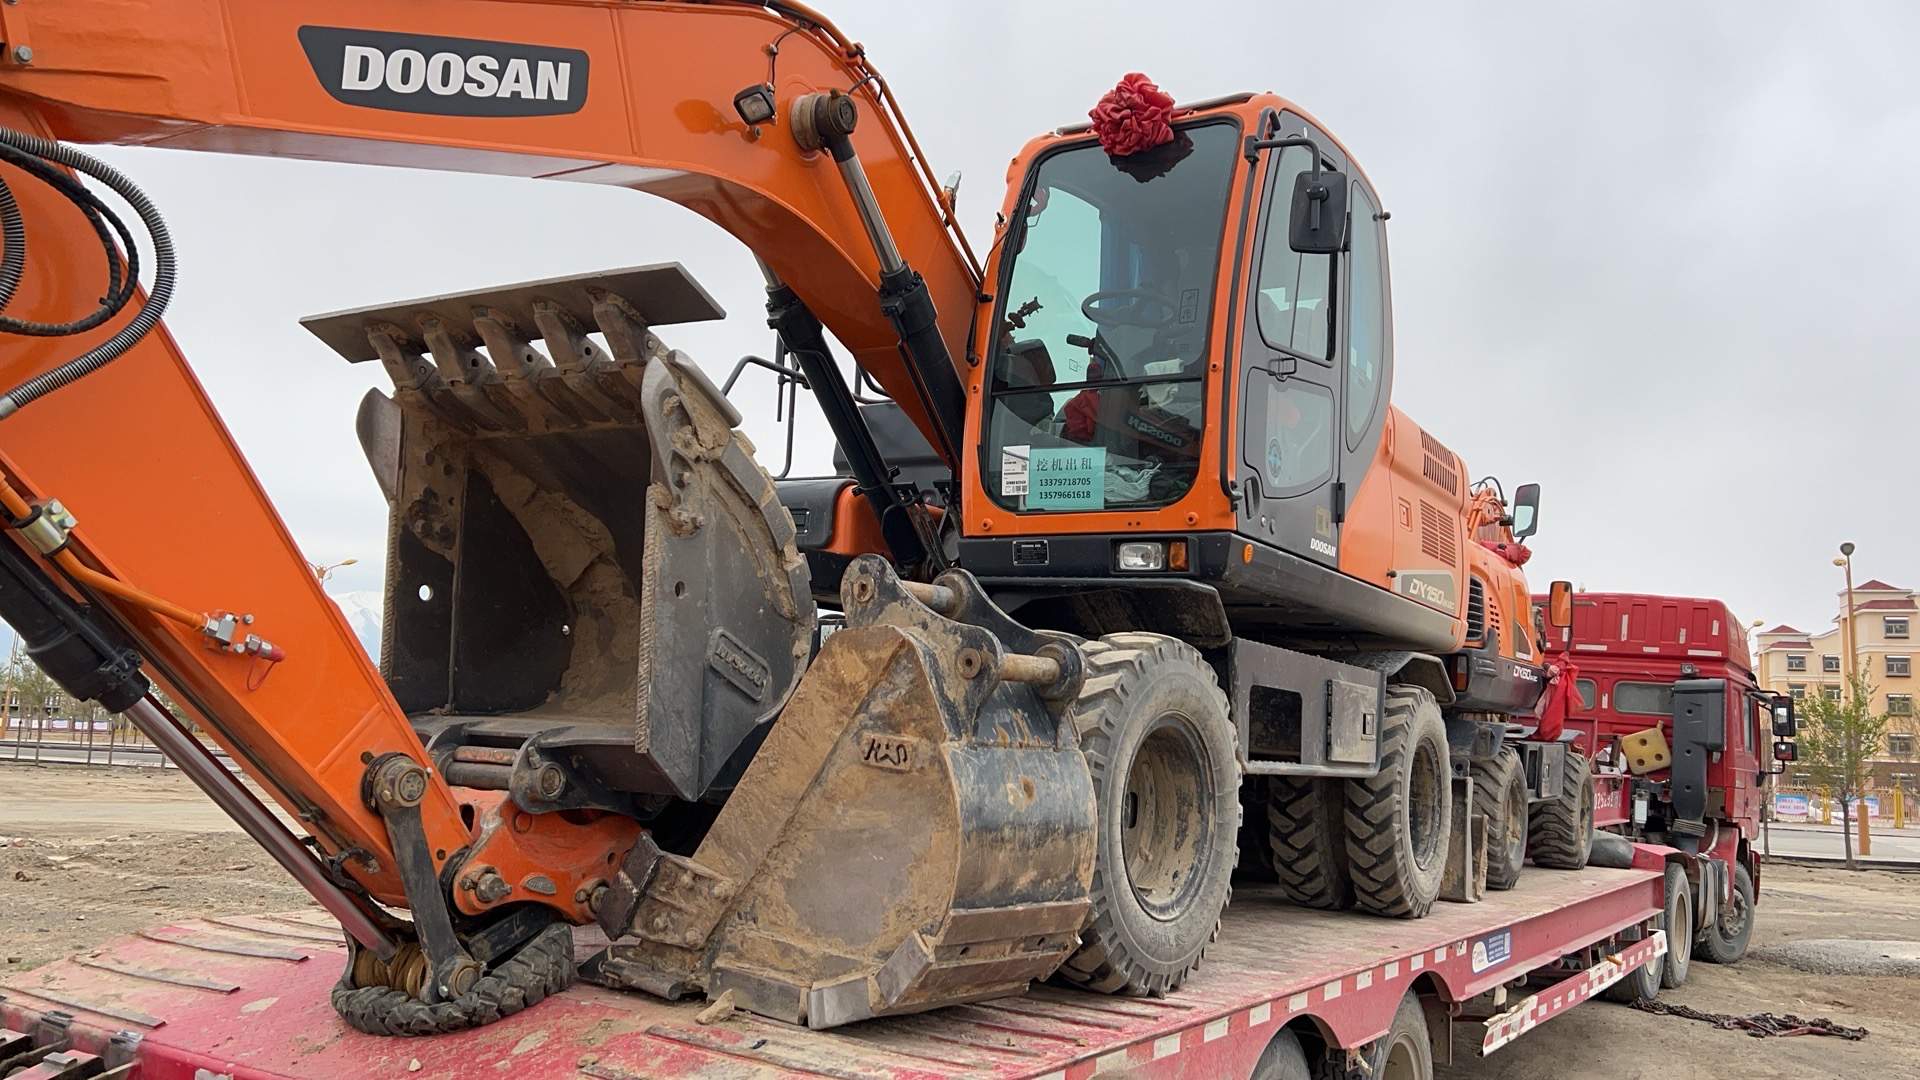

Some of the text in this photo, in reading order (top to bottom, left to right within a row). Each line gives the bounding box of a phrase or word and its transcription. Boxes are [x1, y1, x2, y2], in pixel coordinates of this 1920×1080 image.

[341, 45, 570, 102] DOOSAN
[1036, 457, 1092, 472] 挖机出租
[1039, 477, 1092, 487] 13379718705
[1039, 490, 1091, 499] 13579661618
[1310, 537, 1337, 557] DOOSAN
